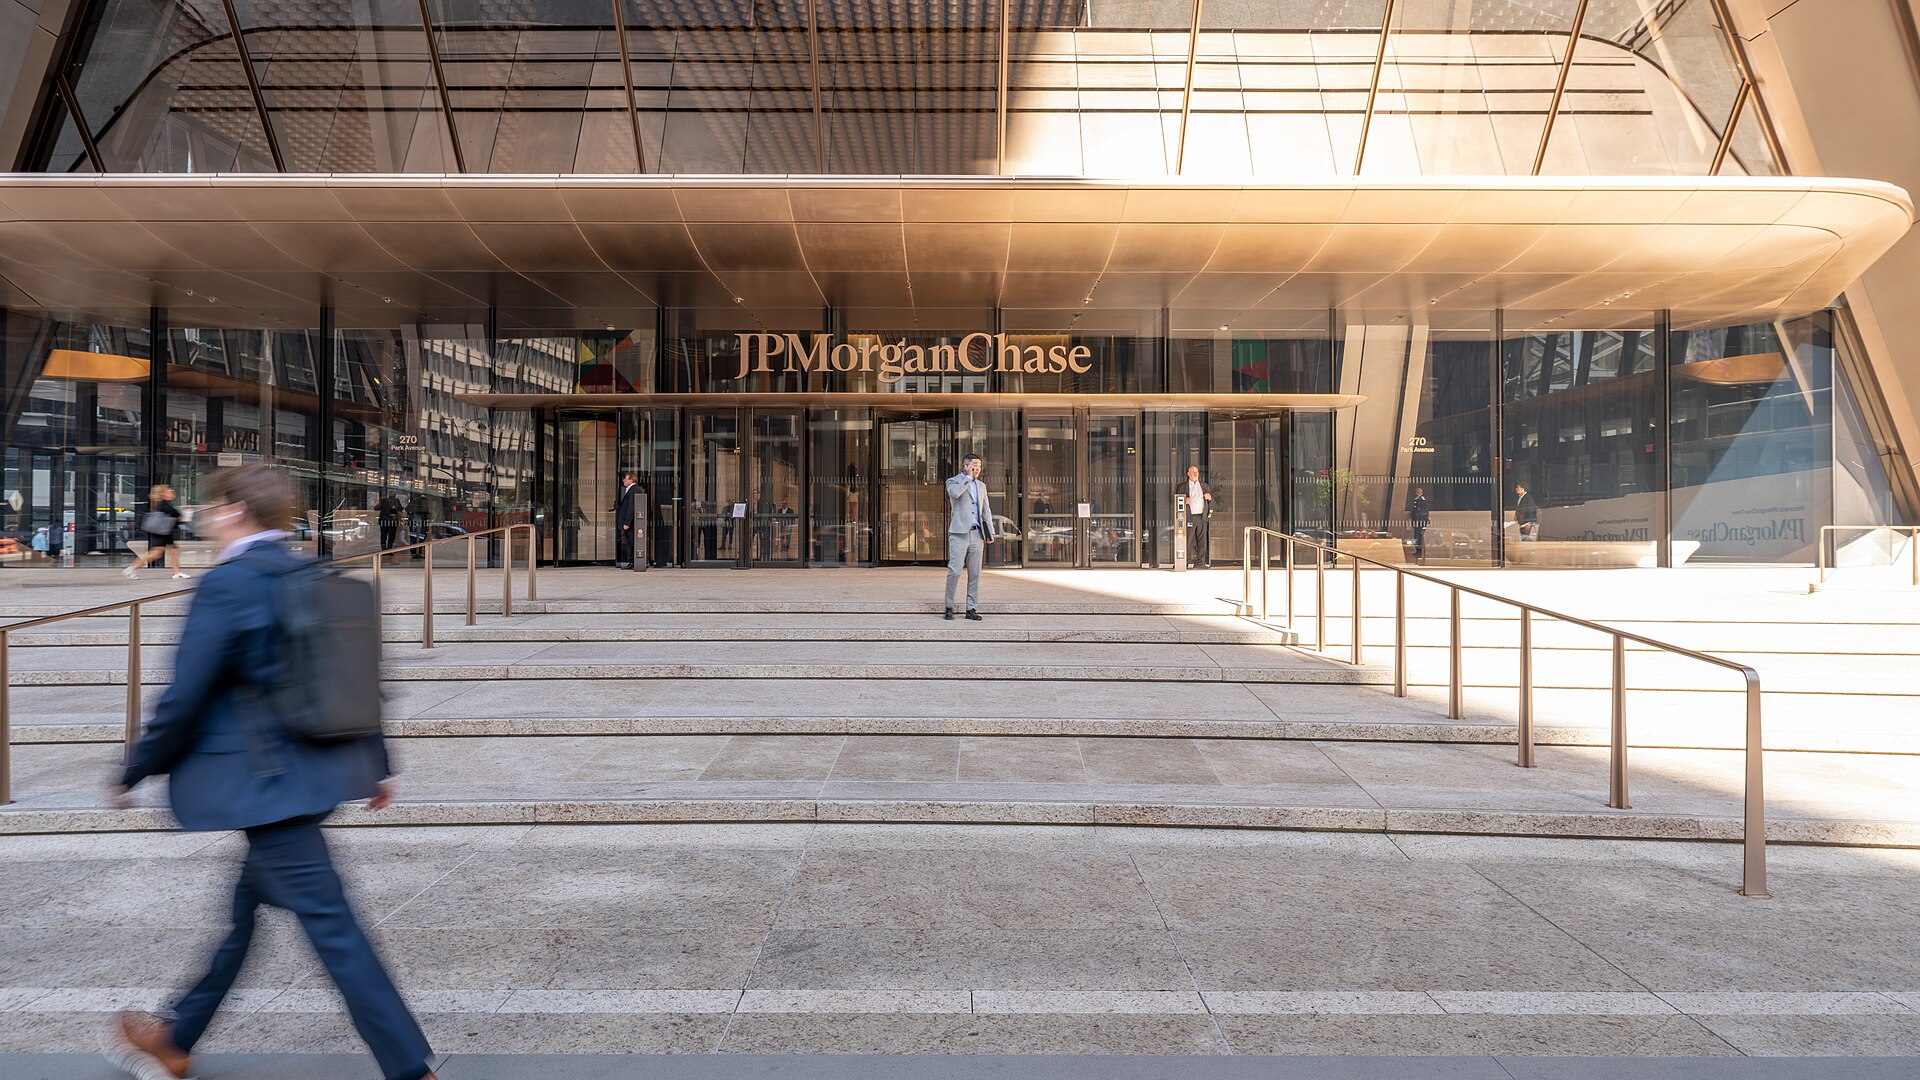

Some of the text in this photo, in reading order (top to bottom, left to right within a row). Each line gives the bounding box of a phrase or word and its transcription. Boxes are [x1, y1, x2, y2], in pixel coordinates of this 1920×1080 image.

[734, 332, 1092, 383] JPMorganChase
[400, 435, 417, 444] 270
[1409, 437, 1427, 446] 270
